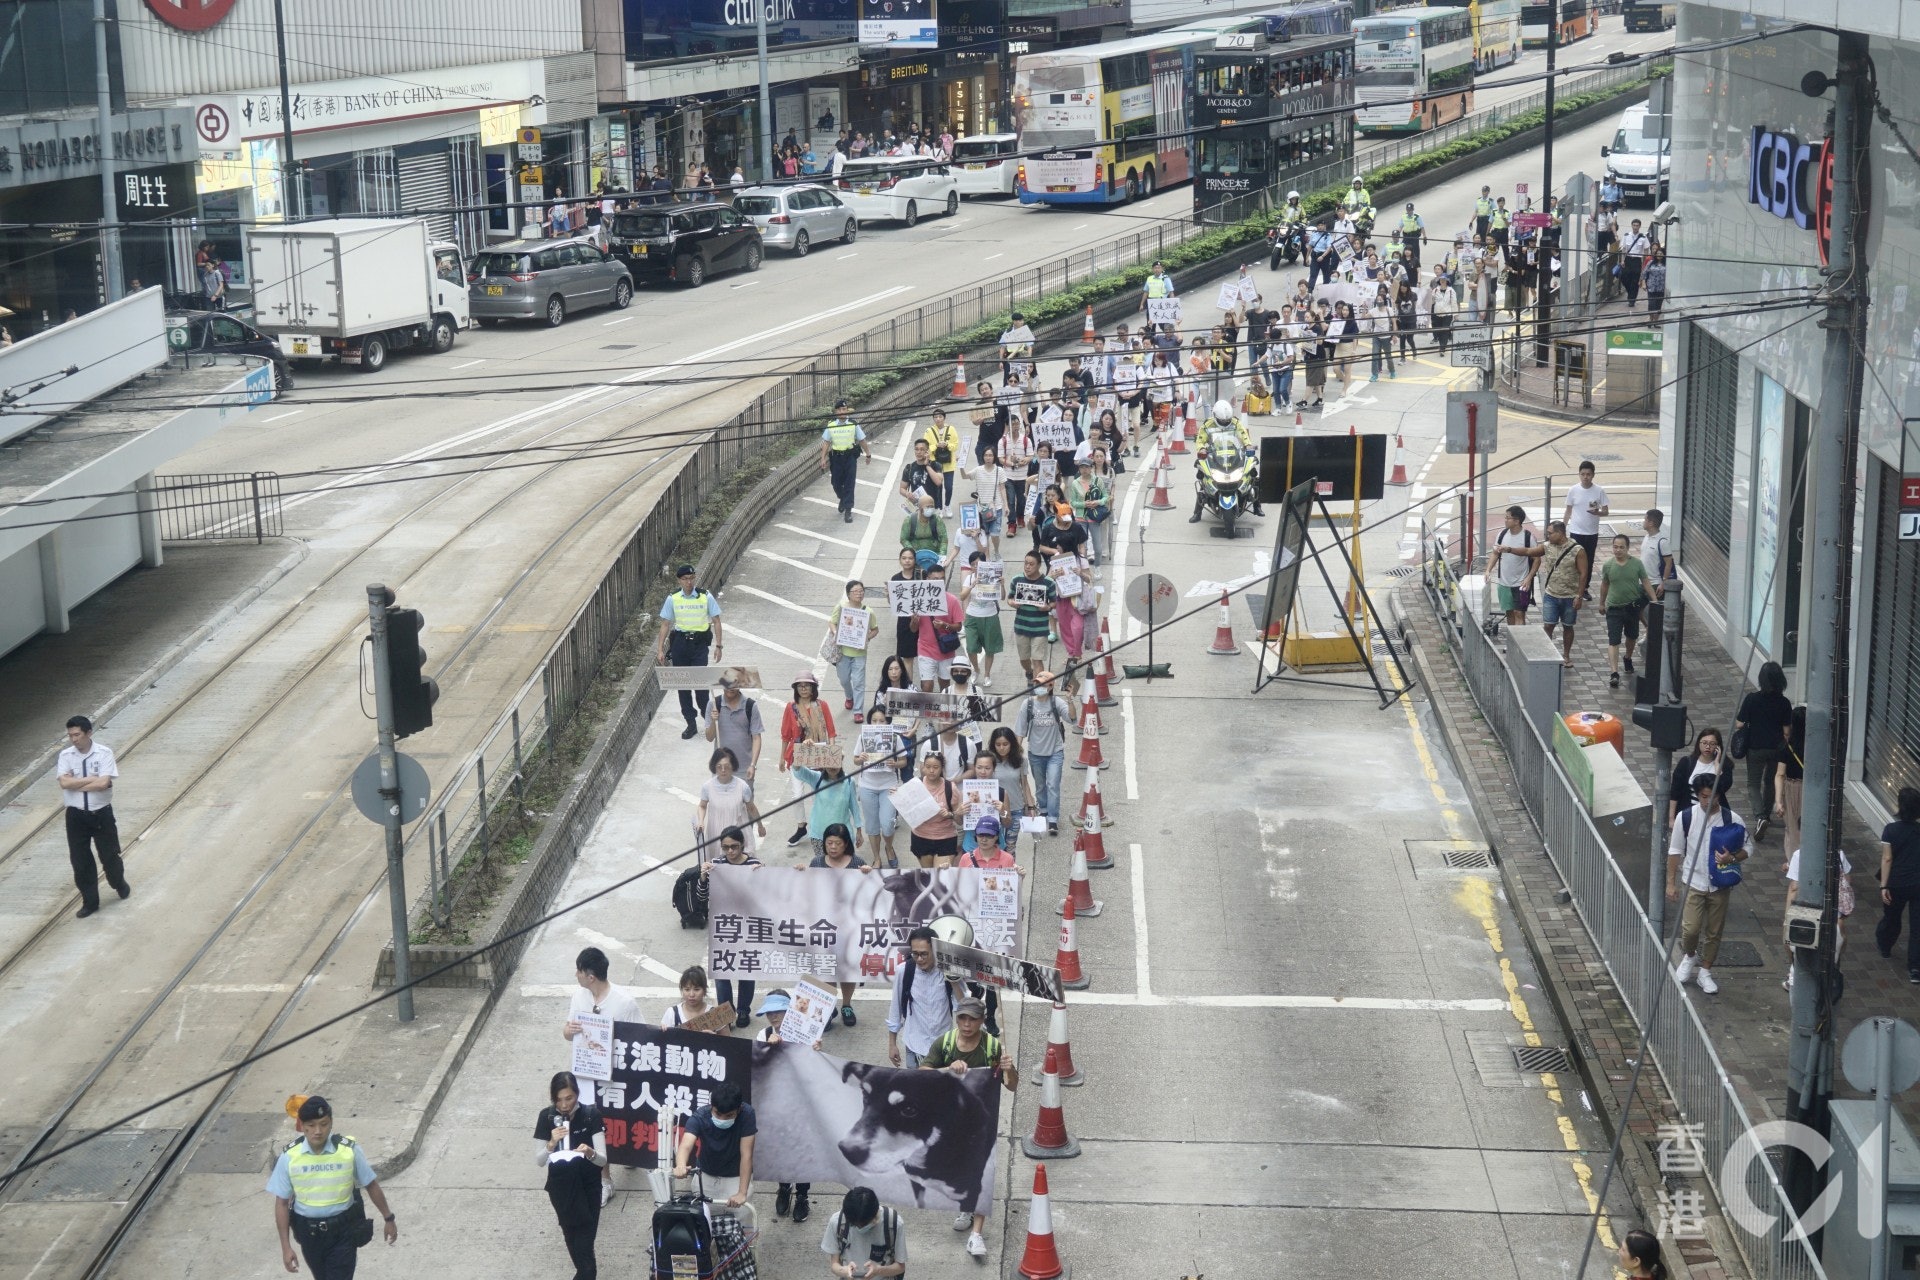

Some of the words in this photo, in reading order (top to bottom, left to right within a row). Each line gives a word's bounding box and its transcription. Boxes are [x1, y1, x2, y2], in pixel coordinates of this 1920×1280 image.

[724, 0, 796, 26] citiank
[937, 25, 994, 35] BREITLING
[1229, 36, 1245, 46] 70
[891, 63, 928, 79] BREITLING
[344, 92, 381, 112] BANK
[383, 90, 401, 106] OF
[402, 85, 443, 105] CHINA
[1206, 98, 1252, 107] JACOB&CO
[111, 126, 166, 160] HOUSE
[125, 174, 169, 207] 周生生
[1748, 125, 1818, 231] ICBC
[892, 582, 942, 600] 愛動物
[713, 914, 838, 949] 尊重生命
[712, 949, 838, 976] 改革漁護署
[310, 1163, 334, 1173] POLICE
